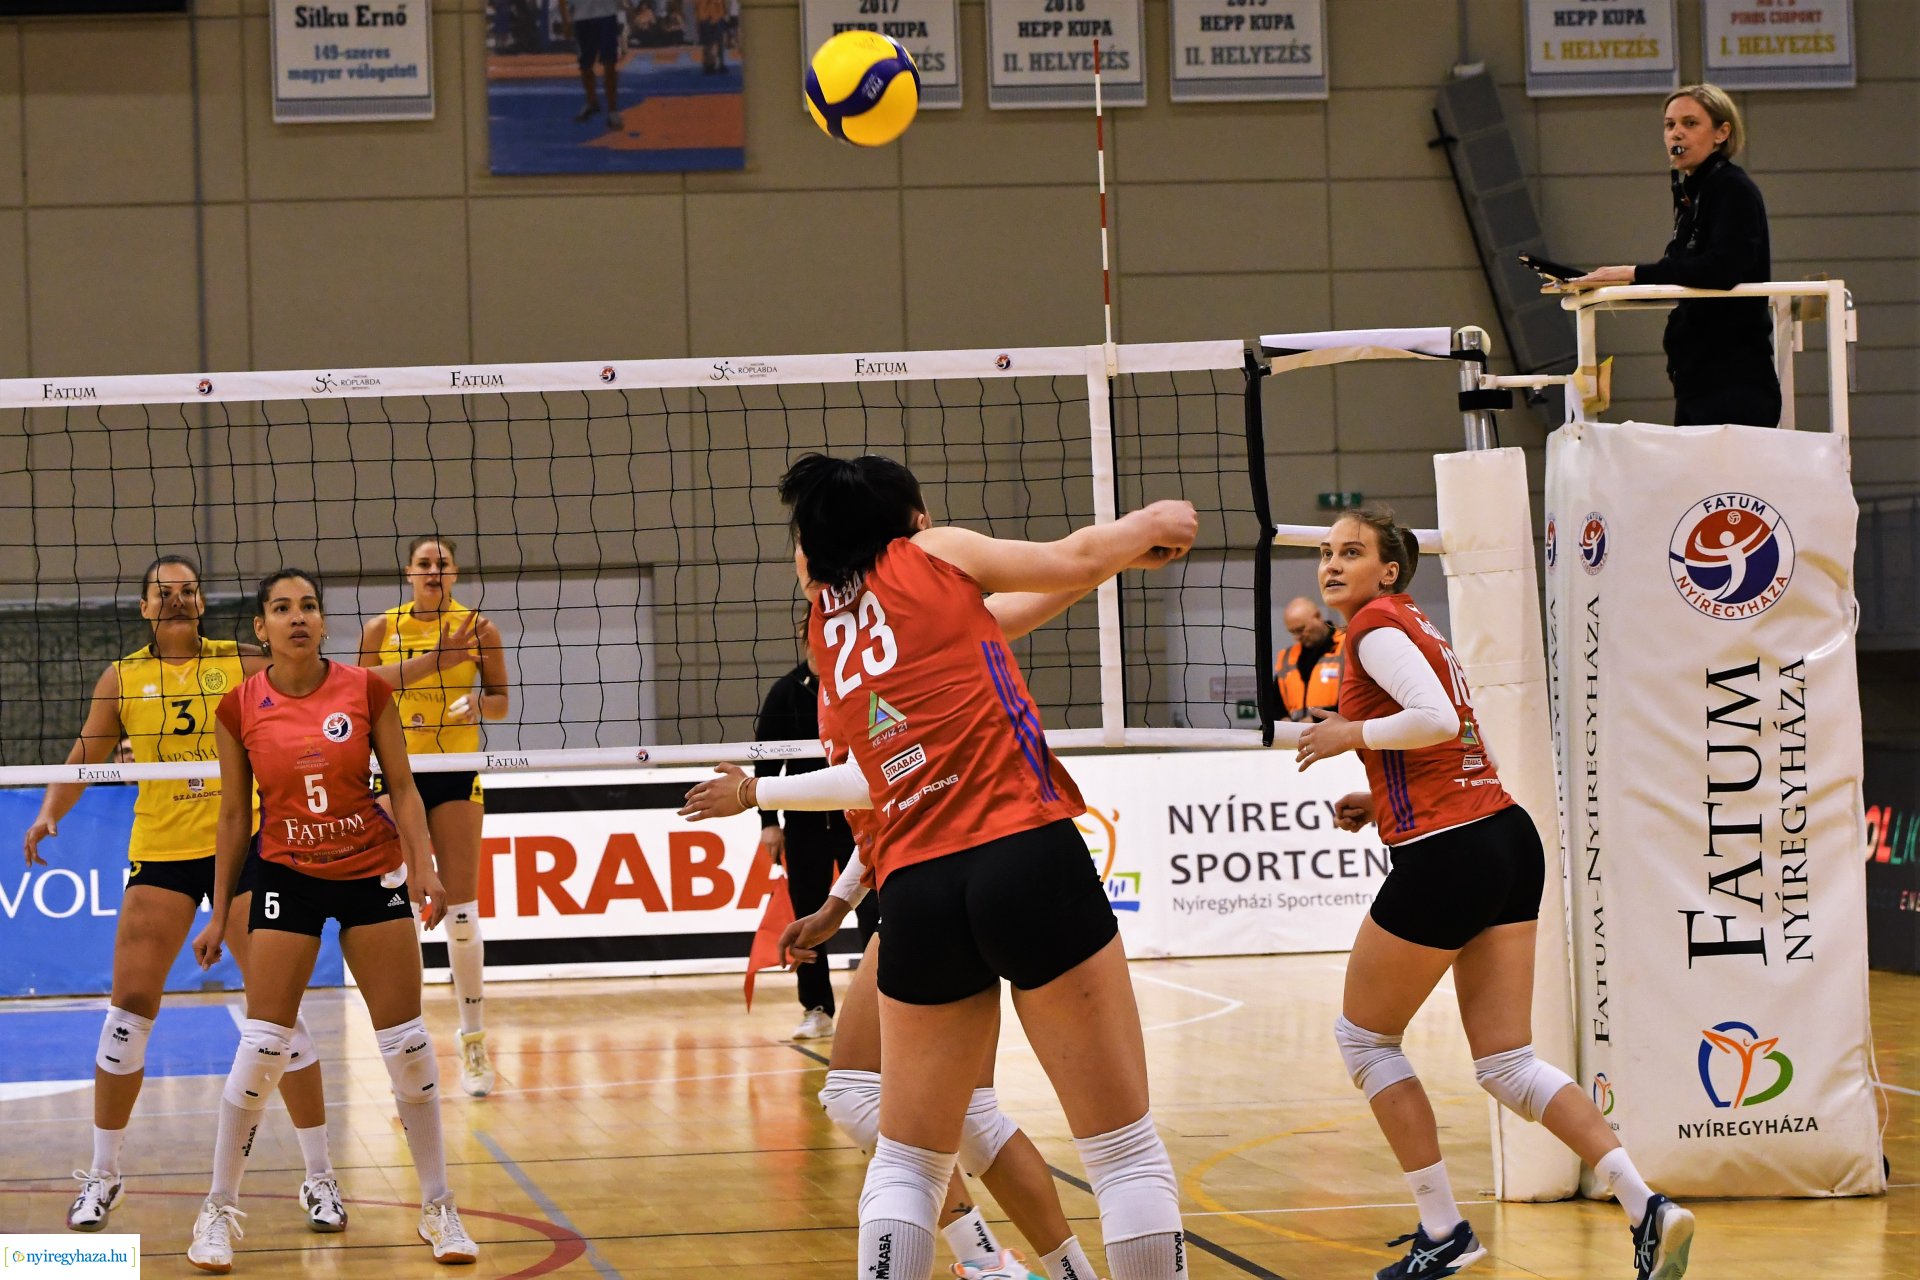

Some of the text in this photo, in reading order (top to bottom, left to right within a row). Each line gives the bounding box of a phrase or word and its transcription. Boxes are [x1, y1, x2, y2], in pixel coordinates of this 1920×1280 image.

[295, 5, 348, 28] Sitku
[1018, 20, 1113, 38] HEPP KUPA
[1201, 13, 1295, 31] HEPP KUPA
[1552, 8, 1646, 26] HEPP KUPA
[1211, 38, 1312, 65] HELYEZÉS
[1561, 32, 1660, 60] HELYEZÉS
[1737, 28, 1836, 55] HELYEZÉS
[1703, 495, 1766, 516] FATUM
[823, 591, 898, 699] 23
[171, 699, 196, 735] 3
[885, 751, 923, 779] STRABAG
[303, 773, 328, 814] 5
[1678, 657, 1767, 969] FATUM
[1773, 655, 1814, 963] NYÍREGYHÁZA
[0, 868, 130, 919] VOL
[264, 891, 280, 919] 5
[1172, 893, 1272, 915] Nyíregyházi
[1678, 1114, 1819, 1139] NYÍREGYHÁZA
[875, 1233, 892, 1279] MIKASA
